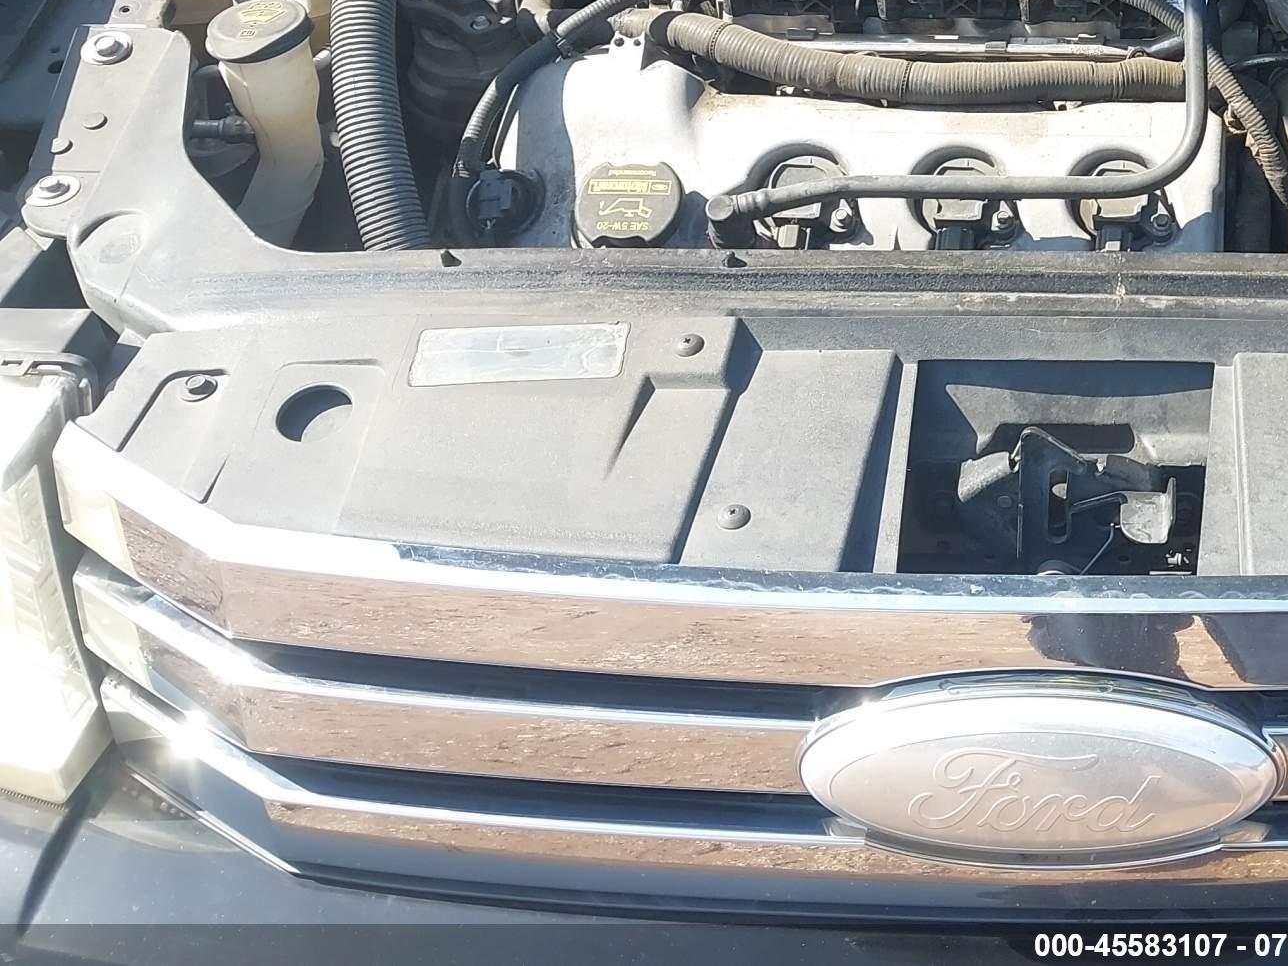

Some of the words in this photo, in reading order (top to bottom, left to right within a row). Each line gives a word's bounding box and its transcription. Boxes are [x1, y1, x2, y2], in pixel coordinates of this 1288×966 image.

[591, 180, 648, 192] Motorcraft
[596, 221, 628, 231] 5W-20
[629, 221, 649, 231] SAE
[907, 746, 1160, 832] Ford
